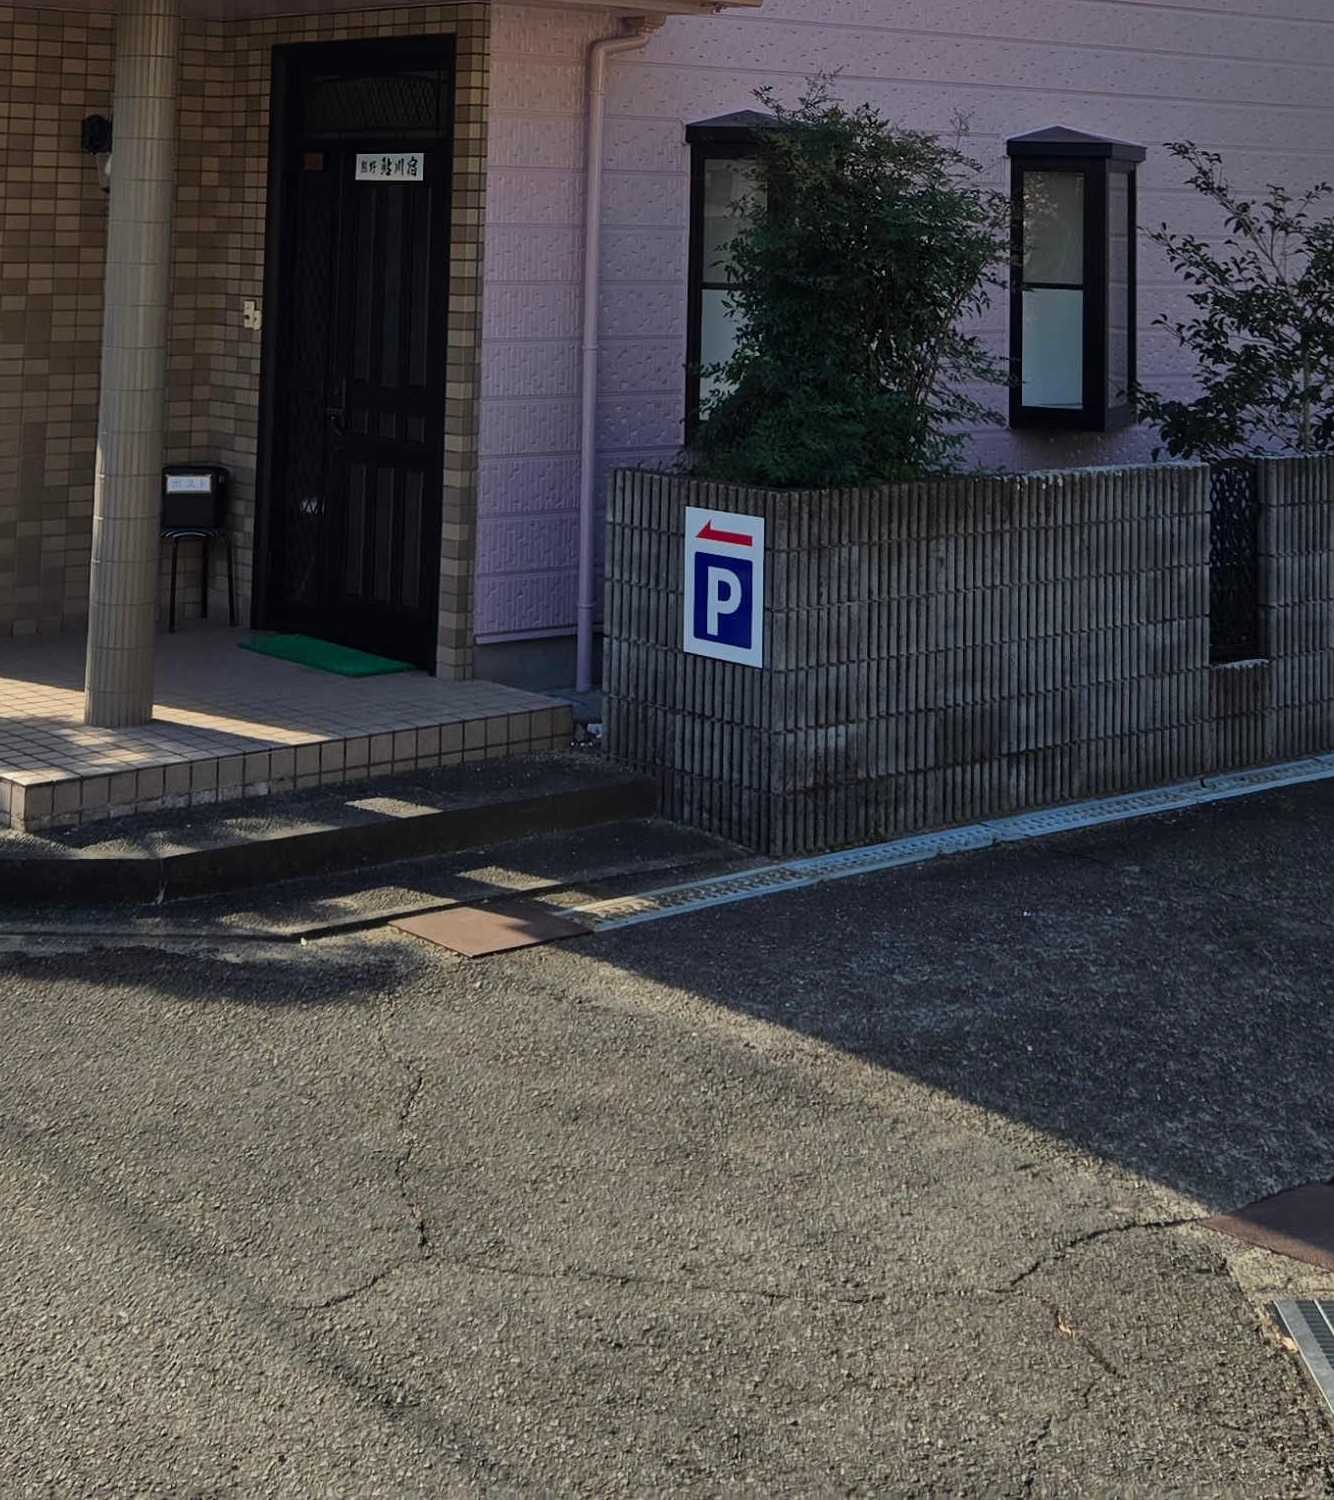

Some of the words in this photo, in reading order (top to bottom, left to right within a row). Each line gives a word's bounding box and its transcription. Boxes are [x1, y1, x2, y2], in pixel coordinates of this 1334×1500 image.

[171, 477, 206, 489] ポスト
[706, 565, 742, 636] P
